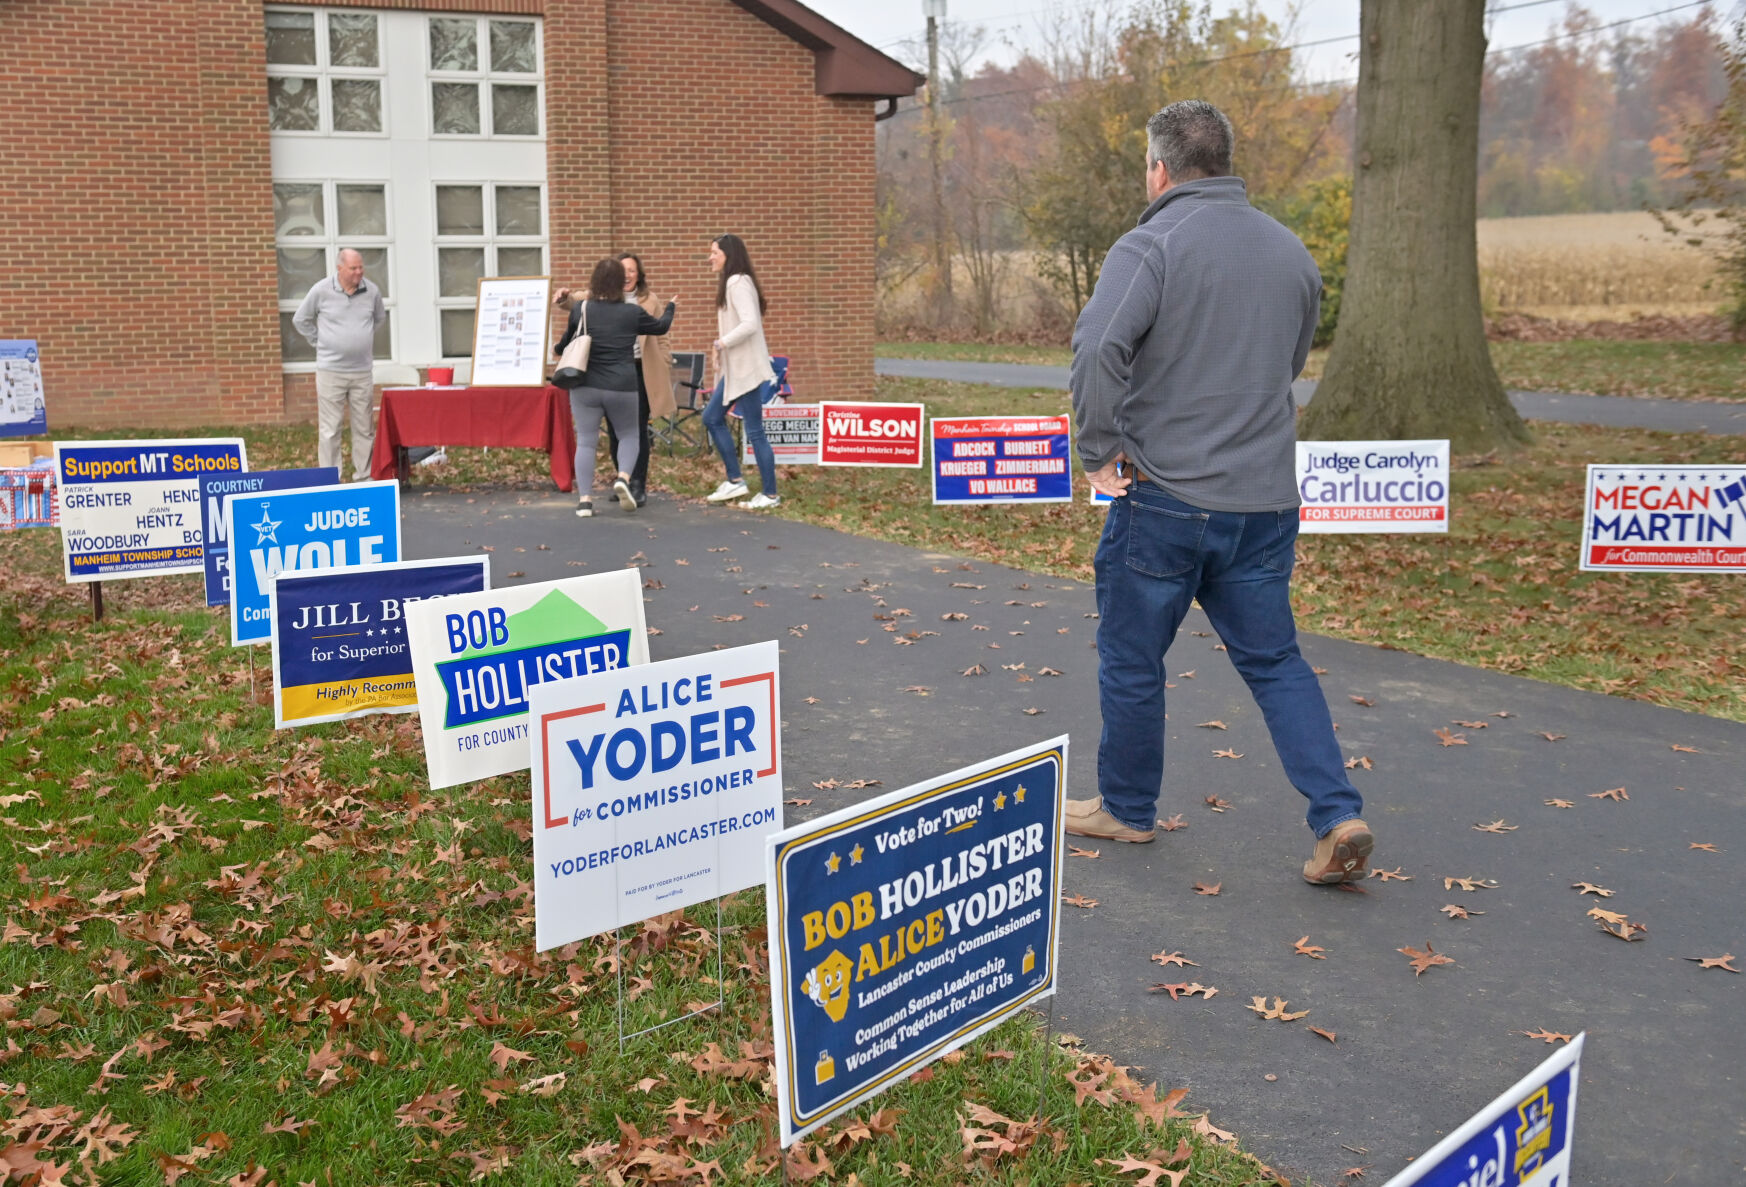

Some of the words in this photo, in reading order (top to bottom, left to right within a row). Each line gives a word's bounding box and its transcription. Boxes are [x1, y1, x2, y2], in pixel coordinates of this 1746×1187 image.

[828, 411, 860, 419] Christine
[782, 434, 800, 442] VAN
[826, 418, 916, 438] WILSON
[941, 424, 980, 435] Manheim
[981, 422, 1012, 436] Township
[1014, 422, 1038, 432] SCHOOL
[826, 446, 866, 454] Magisterial
[866, 446, 893, 454] District
[894, 447, 915, 456] Judge
[954, 442, 996, 457] ADCOCK
[1004, 440, 1050, 456] BURNETT
[64, 457, 138, 479] Support
[139, 453, 169, 474] MT
[172, 454, 240, 472] Schools
[940, 461, 987, 476] KRUEGER
[996, 459, 1064, 475] ZIMMERMAN
[1306, 452, 1360, 474] Judge
[1364, 452, 1438, 473] Carolyn
[206, 478, 264, 494] COURTNEY
[970, 480, 986, 494] VO
[986, 478, 1037, 494] WALLACE
[1300, 474, 1444, 502] Carluccio
[1594, 486, 1710, 510] MEGAN
[66, 492, 132, 508] GRENTER
[136, 514, 184, 529] HENTZ
[304, 506, 370, 532] JUDGE
[1306, 508, 1330, 520] FOR
[1331, 508, 1391, 520] SUPREME
[1394, 508, 1438, 519] COURT
[1592, 513, 1733, 542] MARTIN
[68, 534, 150, 552] WOODBURY
[74, 554, 120, 566] MANHEIM
[122, 551, 173, 562] TOWNSHIP
[1602, 548, 1622, 564] for
[1622, 549, 1714, 563] Commonwealth
[292, 602, 370, 630] JILL
[446, 606, 510, 654] BOB
[311, 647, 334, 662] for
[339, 641, 406, 661] Superior
[454, 643, 620, 714] HOLLISTER
[317, 684, 358, 700] Highly
[616, 674, 712, 718] ALICE
[458, 734, 480, 752] FOR
[484, 724, 528, 746] COUNTY
[566, 705, 756, 790] YODER
[572, 806, 592, 827] for
[596, 768, 754, 820] COMMISSIONER
[874, 826, 916, 854] Vote
[918, 816, 941, 839] for
[942, 796, 984, 828] Two!
[550, 808, 775, 878] YODERFORLANCASTER.COM
[625, 888, 636, 896] PAID
[656, 878, 672, 887] YODER
[683, 868, 711, 880] LANCASTER
[801, 890, 876, 951] BOB
[878, 822, 1044, 920] HOLLISTER
[855, 908, 944, 983] ALICE
[946, 867, 1043, 936] YODER
[858, 968, 914, 1009] Lancaster
[916, 946, 956, 977] County
[958, 908, 1042, 956] Commissioners
[855, 1006, 907, 1046] Common
[908, 988, 942, 1016] Sense
[944, 957, 1006, 997] Leadership
[846, 1036, 898, 1072] Working
[897, 1004, 948, 1042] Together
[950, 996, 968, 1014] for
[968, 982, 984, 1005] All
[986, 976, 998, 995] of
[998, 972, 1014, 989] Us
